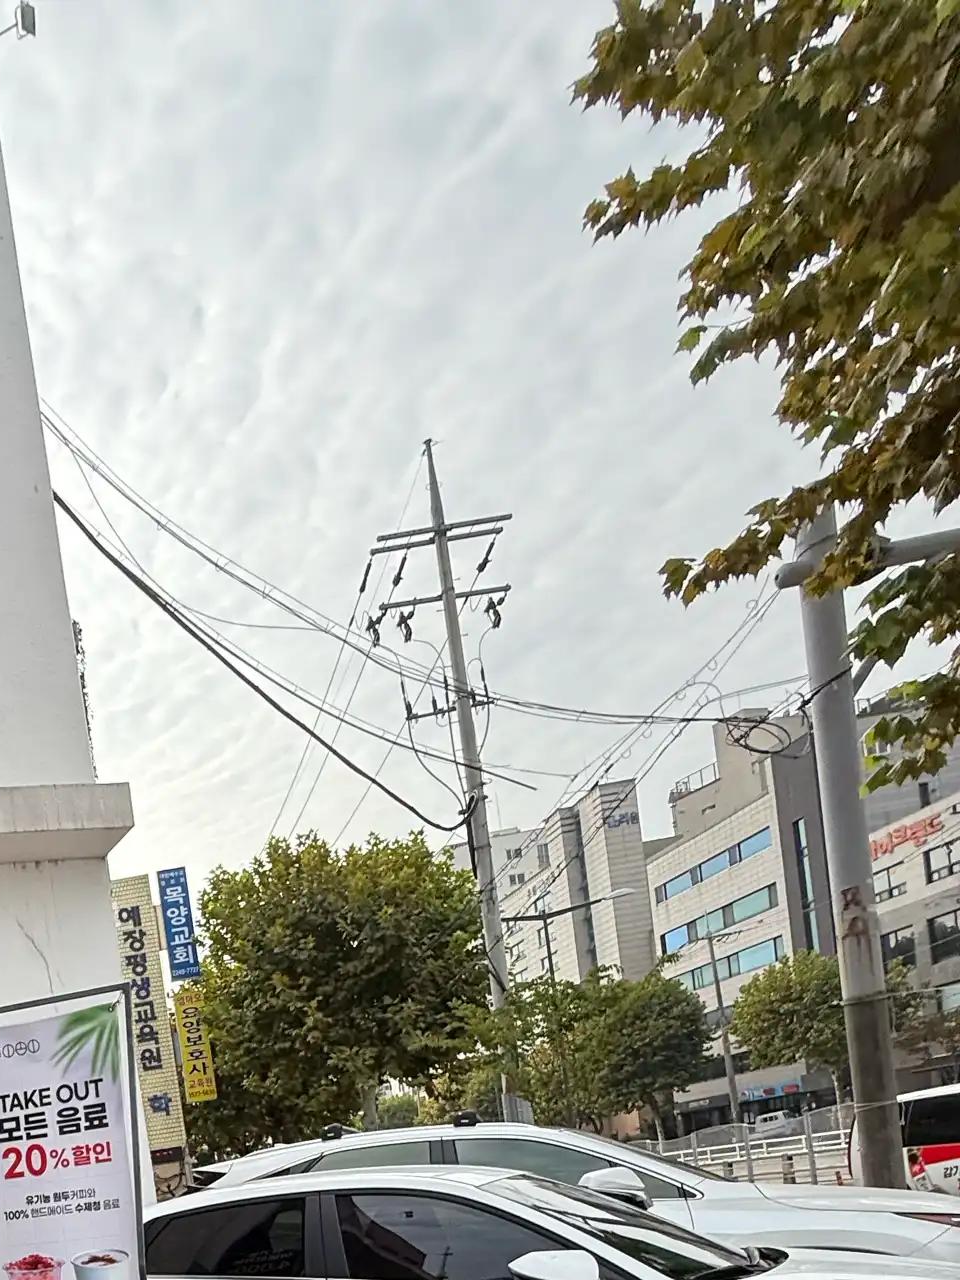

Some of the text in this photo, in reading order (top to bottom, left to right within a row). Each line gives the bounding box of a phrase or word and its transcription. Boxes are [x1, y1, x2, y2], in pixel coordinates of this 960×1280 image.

[164, 886, 194, 963] 목양교회
[182, 1007, 209, 1076] 요양보호사
[56, 1078, 103, 1104] OUT
[56, 1102, 109, 1136] 음료
[4, 1209, 29, 1221] 100%
[30, 1204, 73, 1218] 핸드메이드
[26, 1194, 51, 1206] 유기농
